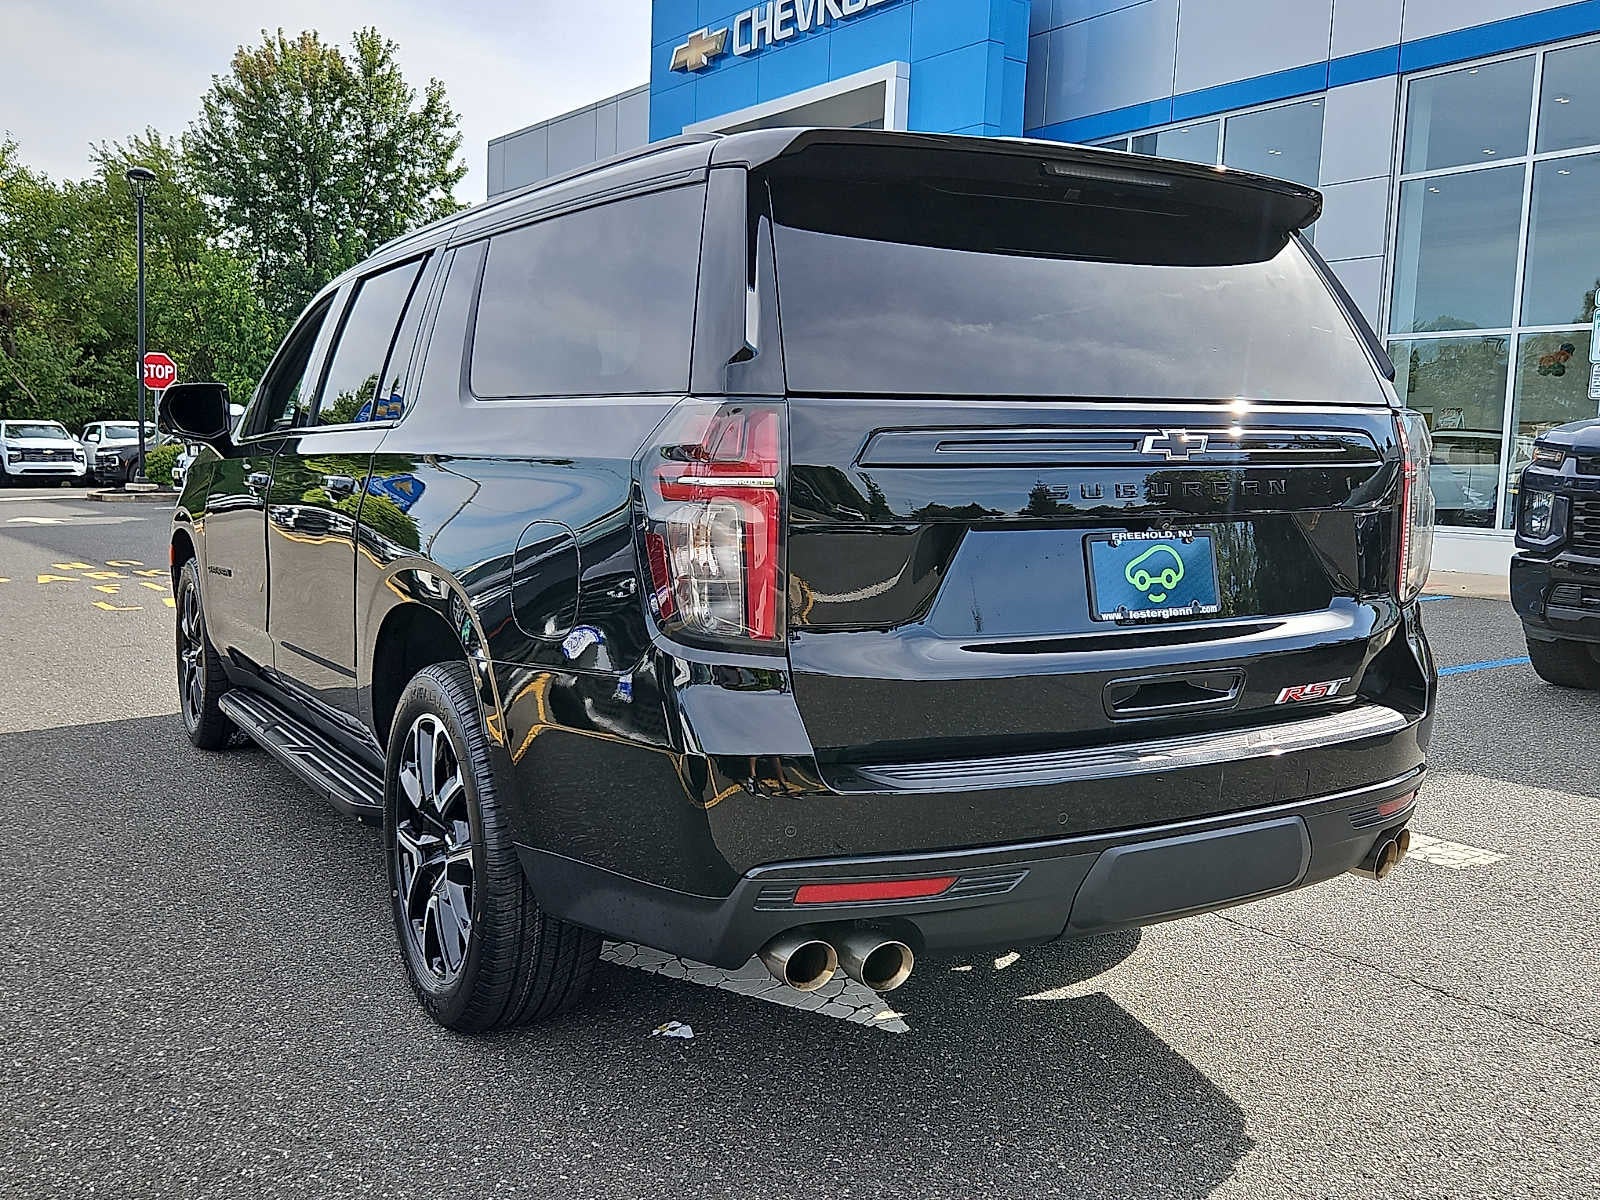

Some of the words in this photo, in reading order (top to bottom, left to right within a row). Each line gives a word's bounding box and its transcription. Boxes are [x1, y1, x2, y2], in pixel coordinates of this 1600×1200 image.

[732, 0, 886, 56] CHEVR
[1046, 479, 1288, 500] SUBURBAN
[1111, 530, 1176, 540] FREEHOLD,
[1178, 529, 1193, 538] NJ
[1274, 676, 1352, 705] RST
